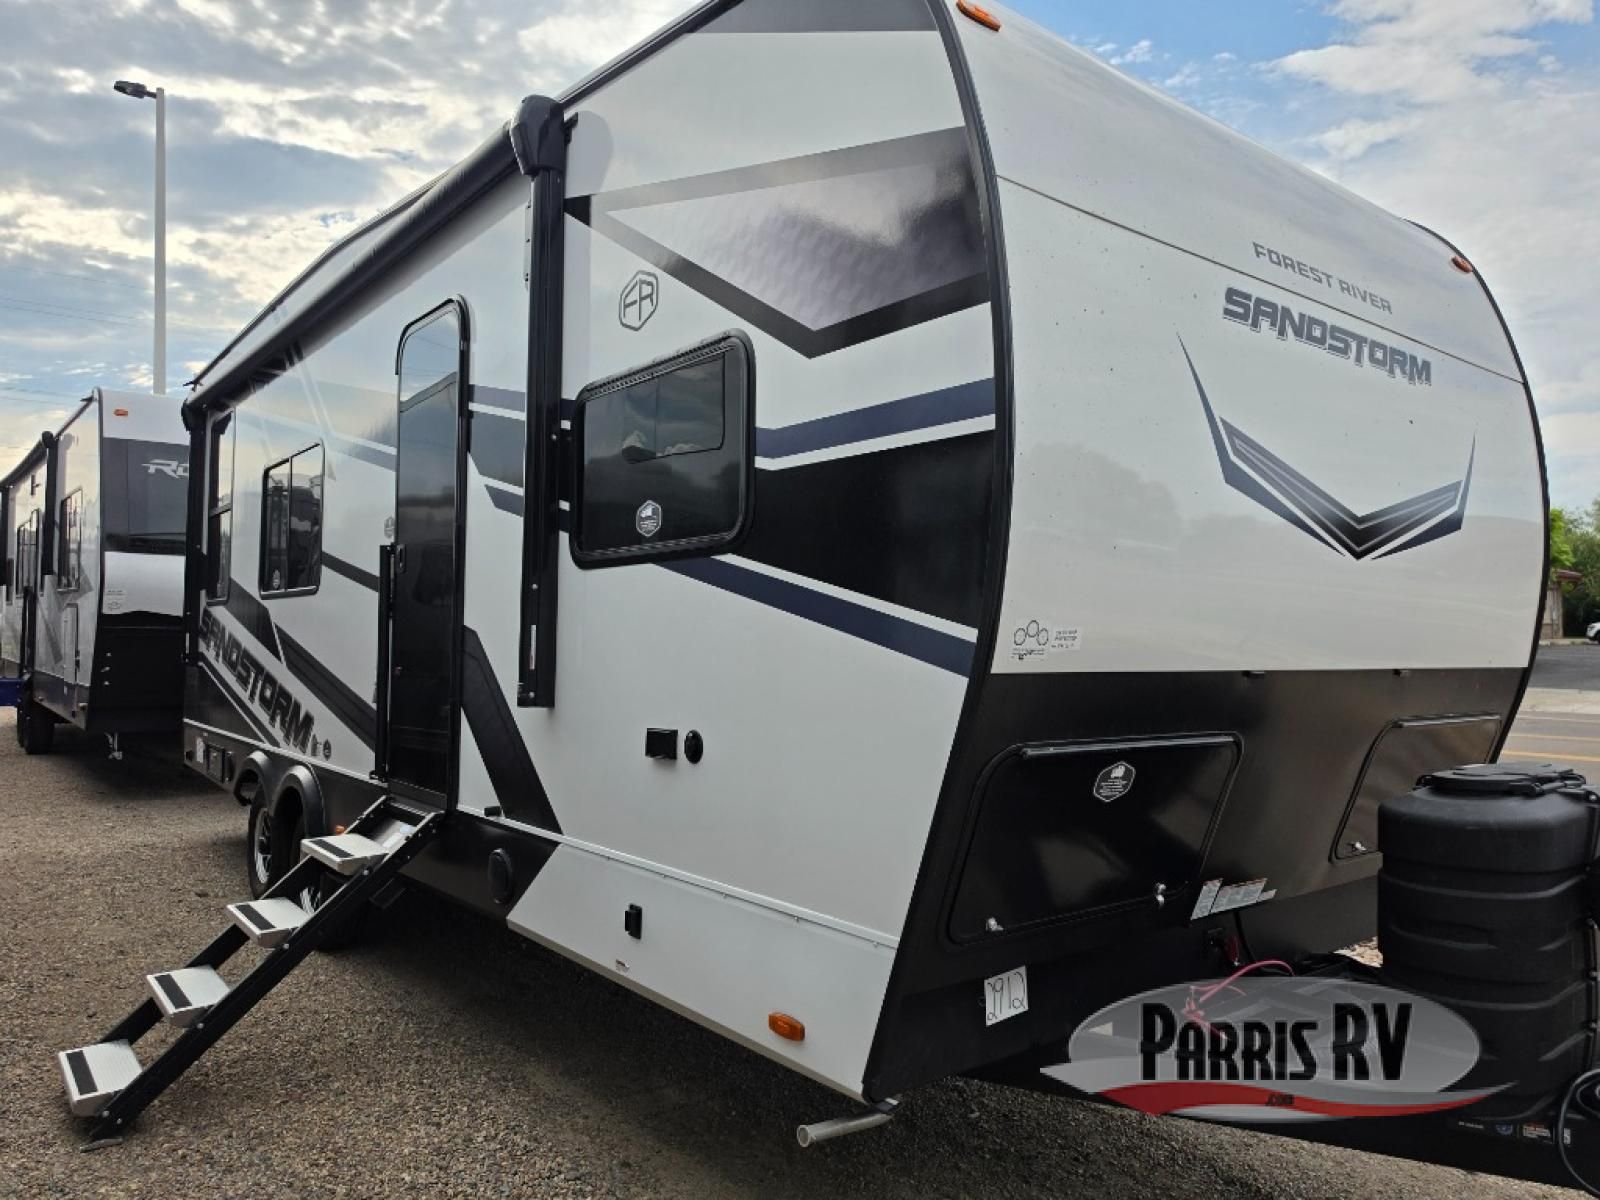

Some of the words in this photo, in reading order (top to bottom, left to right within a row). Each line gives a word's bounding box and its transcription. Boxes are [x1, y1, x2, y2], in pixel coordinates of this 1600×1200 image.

[1252, 241, 1333, 289] FOREST
[1338, 277, 1393, 315] RIVER
[1223, 286, 1433, 387] SANDSTORM
[200, 606, 315, 754] SANDSTORM
